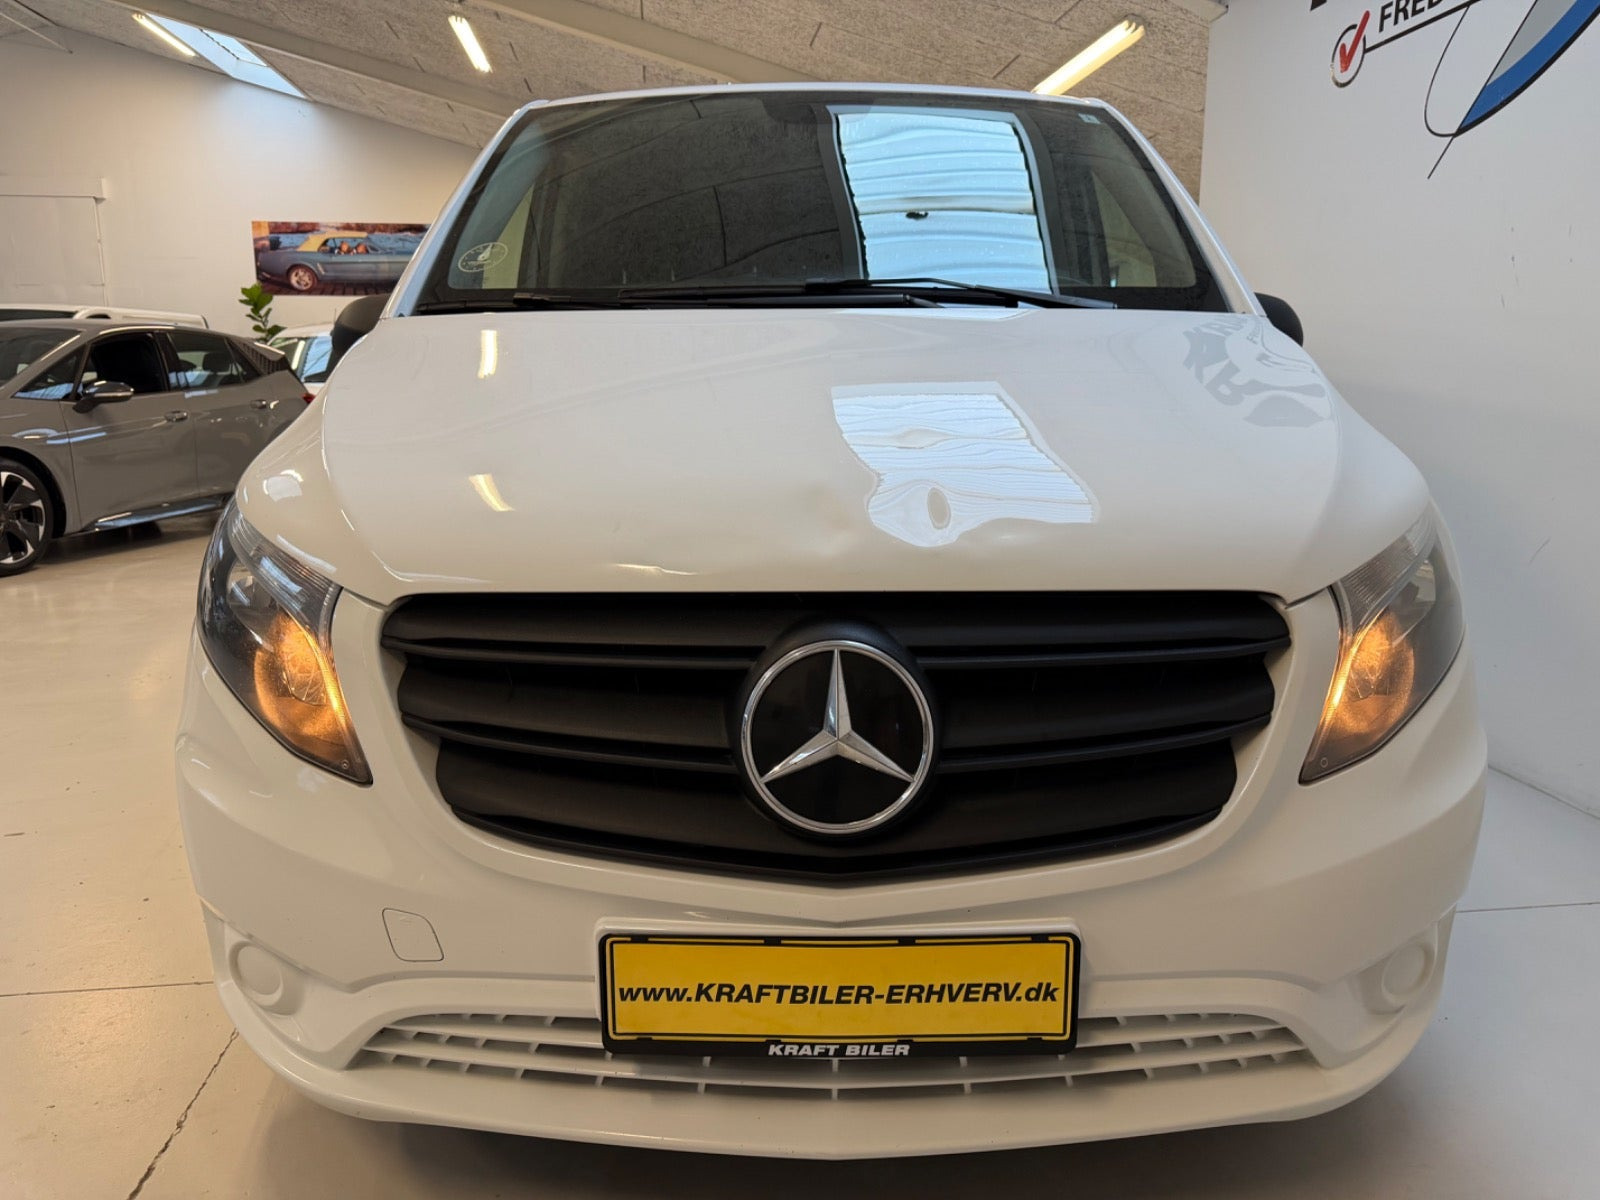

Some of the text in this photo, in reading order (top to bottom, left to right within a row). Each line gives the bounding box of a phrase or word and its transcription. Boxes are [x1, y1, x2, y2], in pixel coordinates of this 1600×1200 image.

[618, 982, 1059, 1005] www.KRAFTBILER-ERHVERV.dk
[768, 1044, 910, 1056] KRAFT BILER
